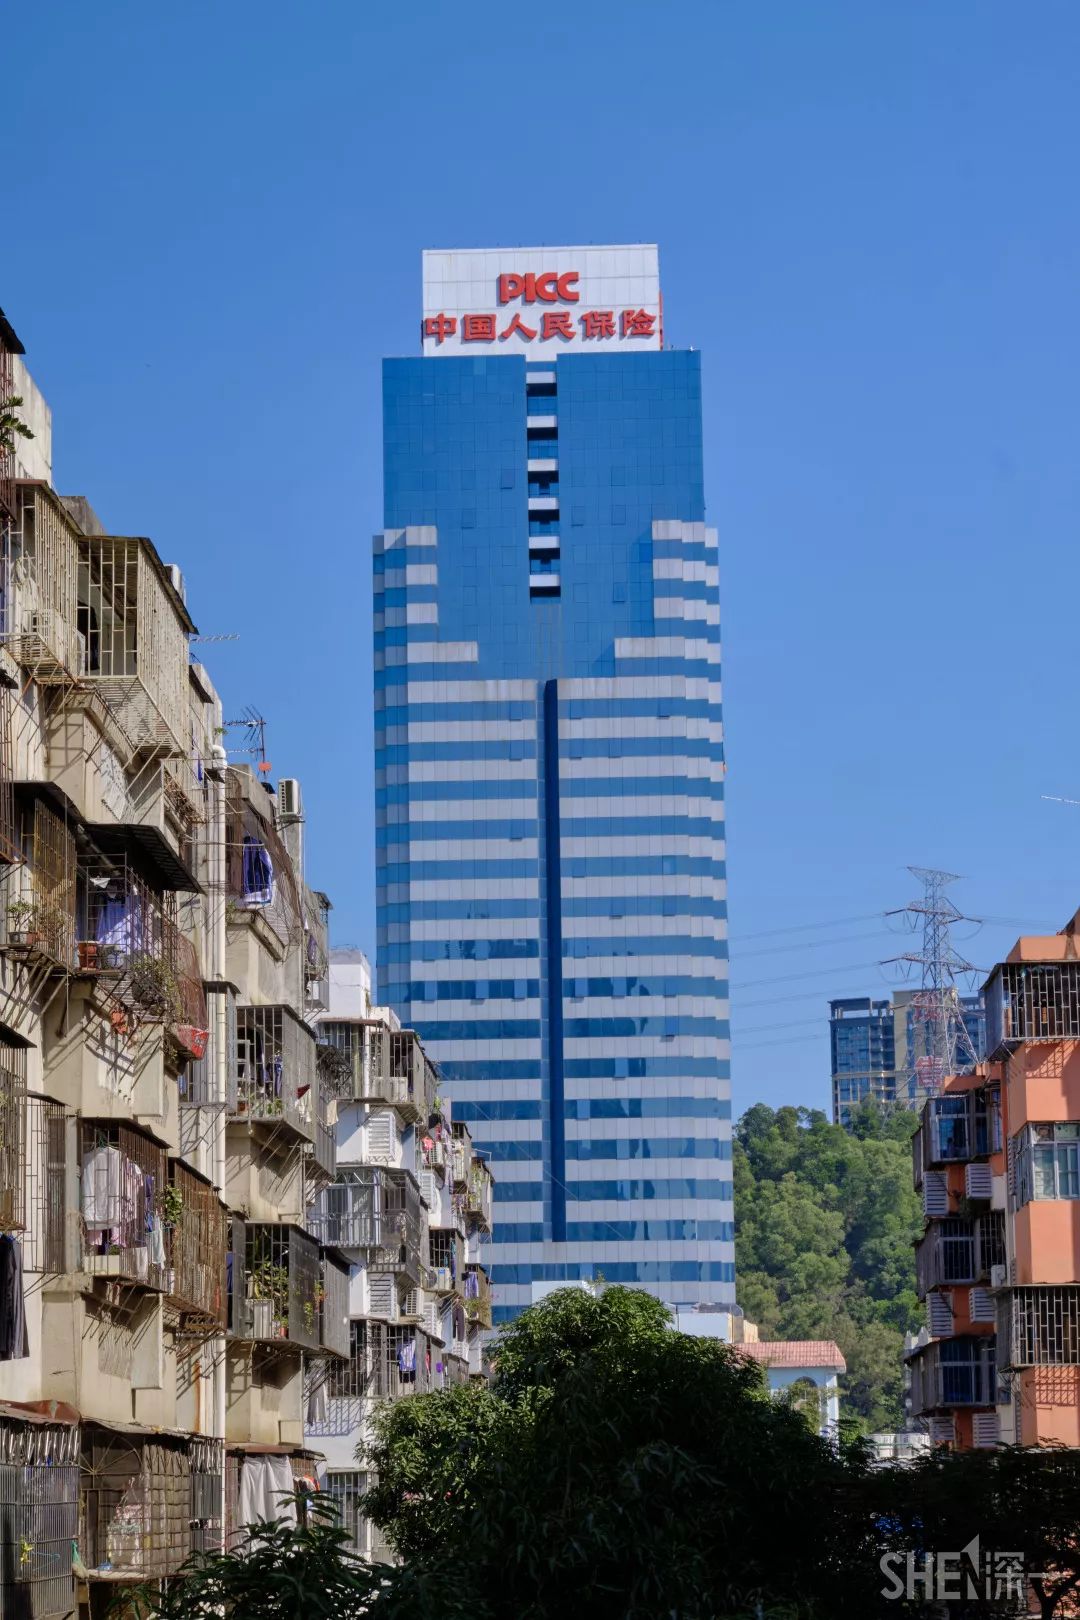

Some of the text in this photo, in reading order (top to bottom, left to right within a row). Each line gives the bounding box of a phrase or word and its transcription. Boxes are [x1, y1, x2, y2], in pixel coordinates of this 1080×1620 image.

[499, 272, 579, 303] PICC
[425, 308, 657, 343] 中国人民保险
